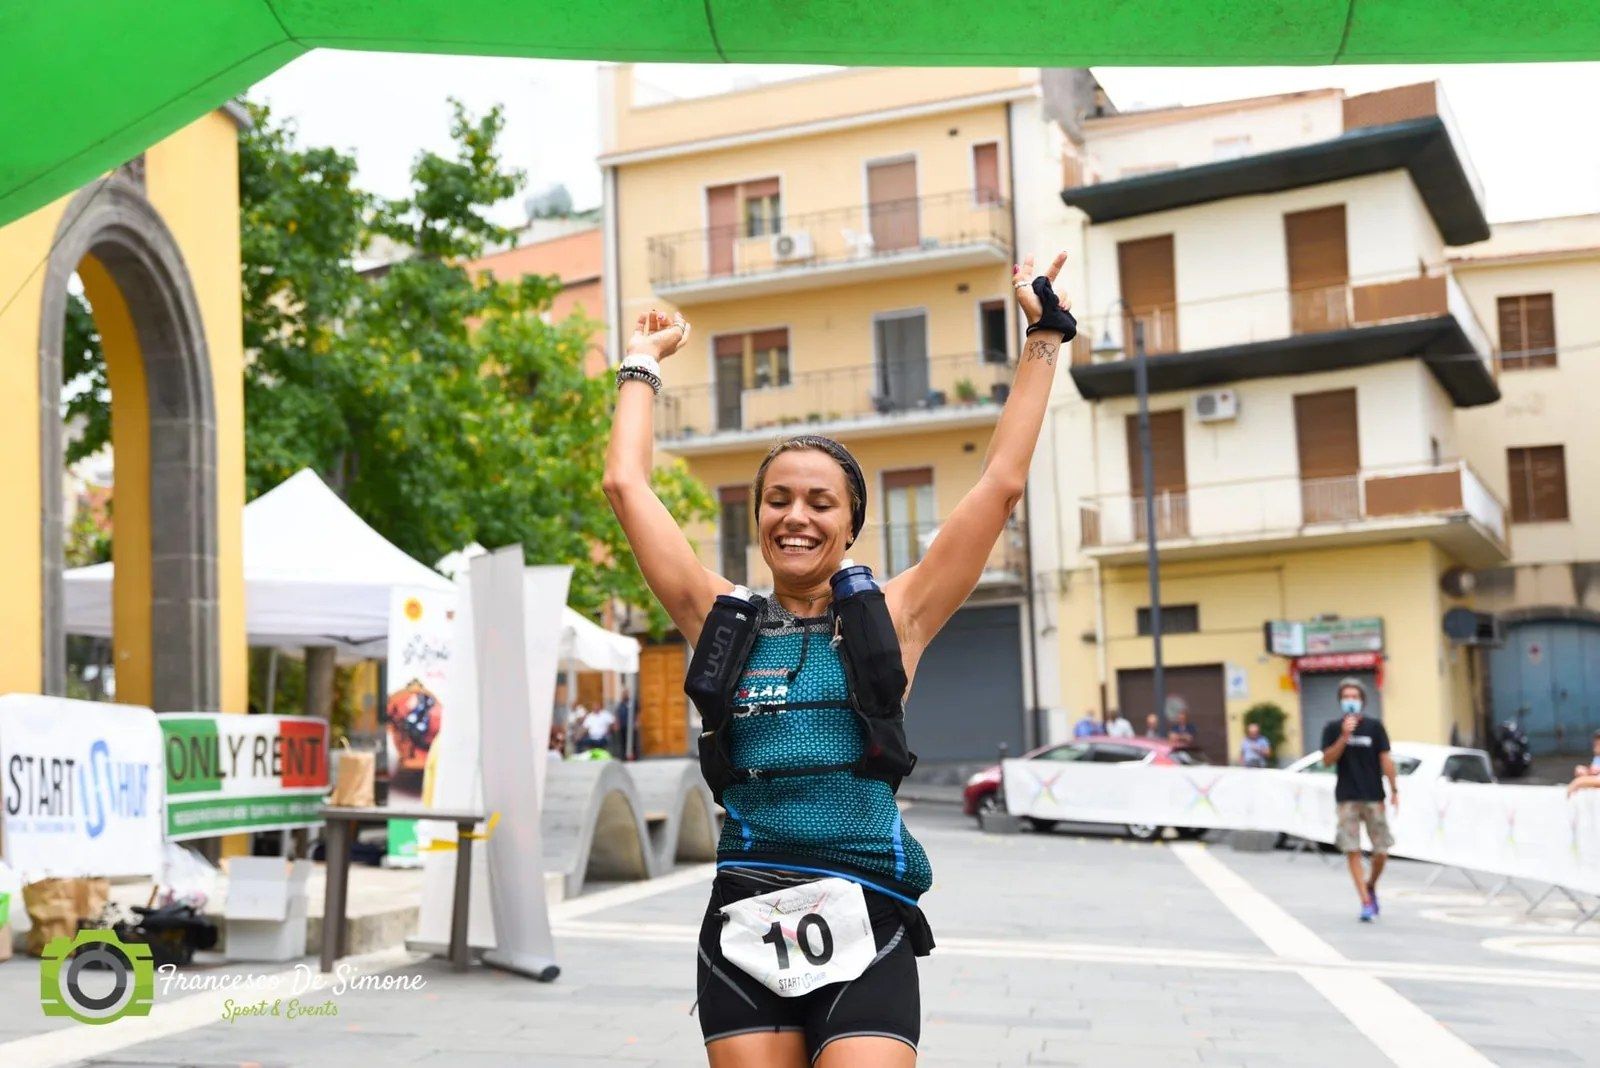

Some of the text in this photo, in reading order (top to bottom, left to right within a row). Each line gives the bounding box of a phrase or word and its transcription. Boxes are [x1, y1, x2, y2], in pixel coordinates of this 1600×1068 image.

[5, 754, 76, 817] START
[167, 735, 322, 781] ONLY RENT
[762, 912, 834, 970] 10
